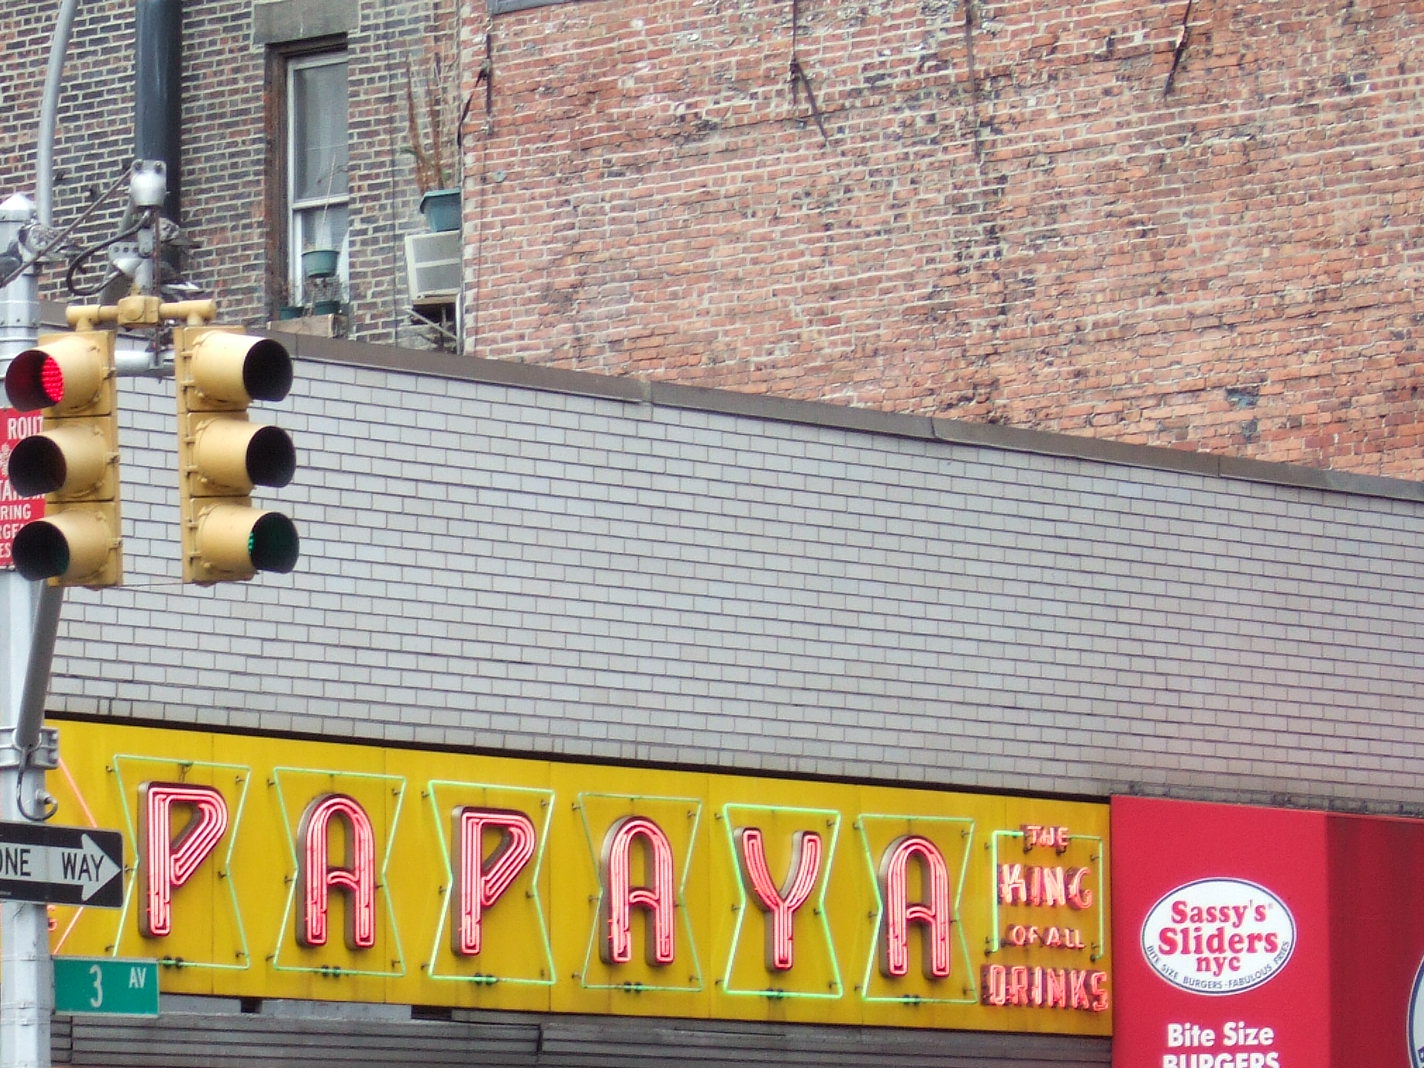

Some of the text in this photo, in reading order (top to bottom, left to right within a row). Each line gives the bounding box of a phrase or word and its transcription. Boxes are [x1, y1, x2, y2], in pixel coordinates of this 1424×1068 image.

[8, 415, 44, 441] ROUT
[1022, 825, 1070, 847] THE
[62, 853, 105, 882] WAY
[134, 776, 951, 983] PAPAYA
[998, 863, 1093, 909] KING
[1171, 899, 1267, 928] Sassy's
[1010, 925, 1086, 948] OF ALL
[1158, 926, 1279, 955] Sliders
[1147, 945, 1159, 966] BITE
[1161, 963, 1179, 980] SIZE
[1182, 975, 1223, 989] BURGERS
[1274, 940, 1290, 965] FRIES
[1196, 955, 1241, 977] nyc
[89, 964, 147, 1008] 3 AV
[982, 964, 1110, 1011] DRINKS
[1167, 1021, 1275, 1047] Bite Size
